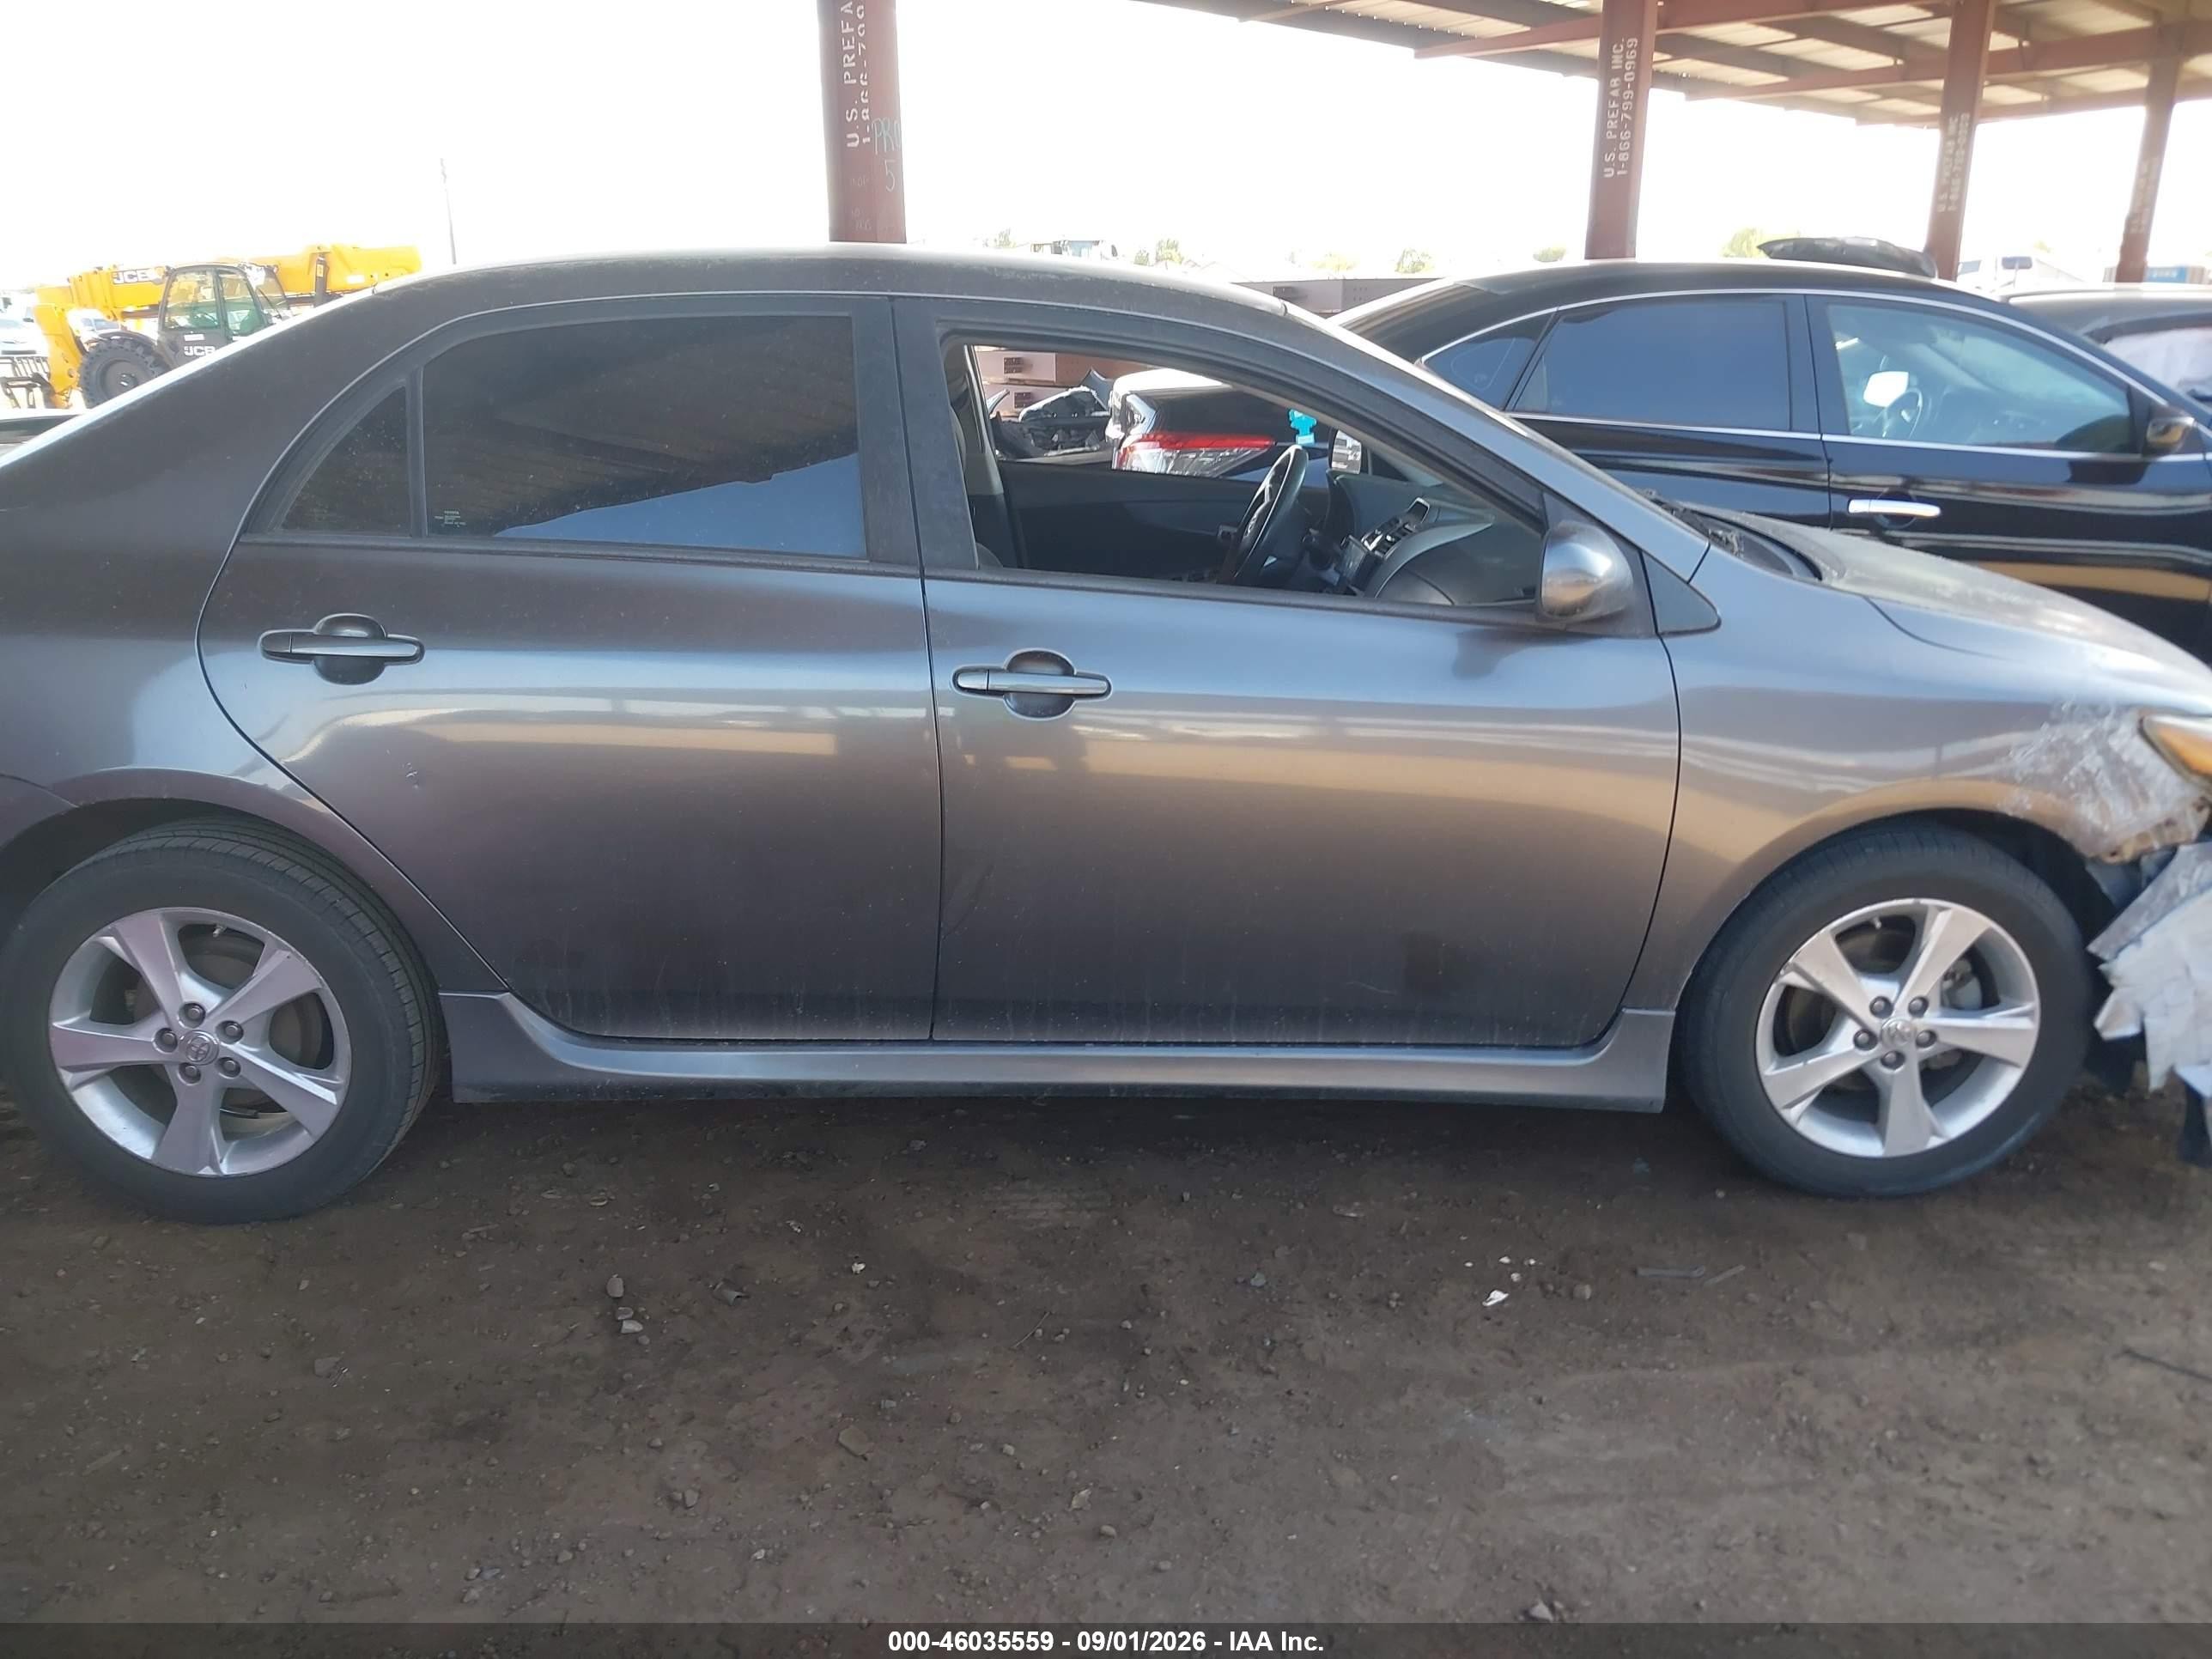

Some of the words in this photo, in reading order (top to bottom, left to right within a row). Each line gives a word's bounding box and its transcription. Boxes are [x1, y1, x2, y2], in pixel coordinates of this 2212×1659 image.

[1611, 38, 1625, 70] INC.
[845, 100, 860, 148] U.S.
[1606, 76, 1621, 140] PREFAB
[1616, 37, 1638, 176] 1-866-799-0969
[1603, 147, 1616, 178] U.S.
[111, 268, 149, 284] JCB
